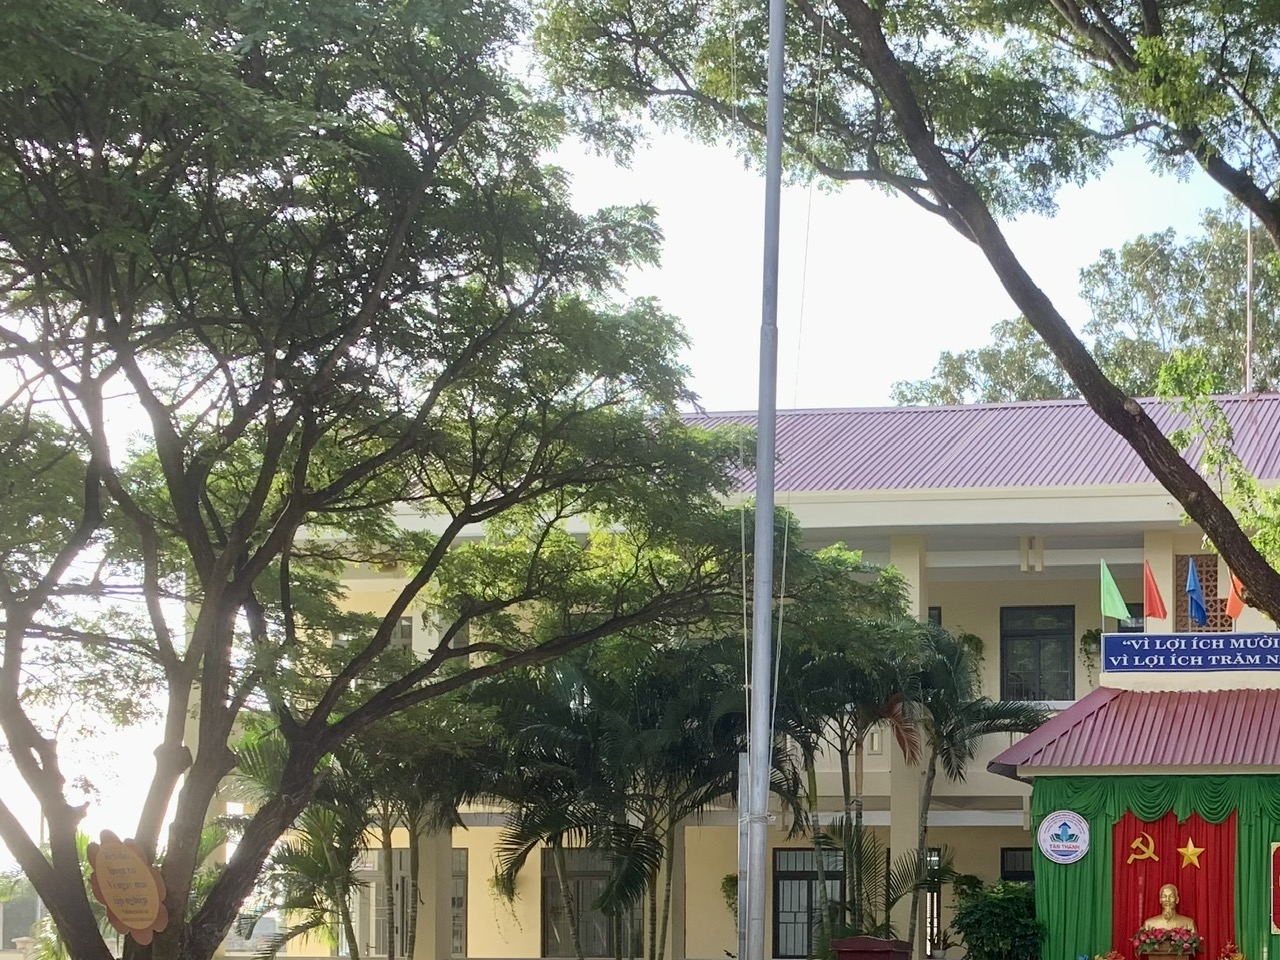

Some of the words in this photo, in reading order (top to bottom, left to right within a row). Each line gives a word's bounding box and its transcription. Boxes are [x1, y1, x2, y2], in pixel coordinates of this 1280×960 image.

[1155, 638, 1186, 651] LỢI
[1191, 636, 1224, 649] ÍCH
[1229, 634, 1279, 649] MƯỜI
[1109, 653, 1129, 666] VÌ
[1133, 654, 1165, 667] LỢI
[1169, 653, 1202, 666] ÍCH
[1208, 651, 1261, 665] TRĂM
